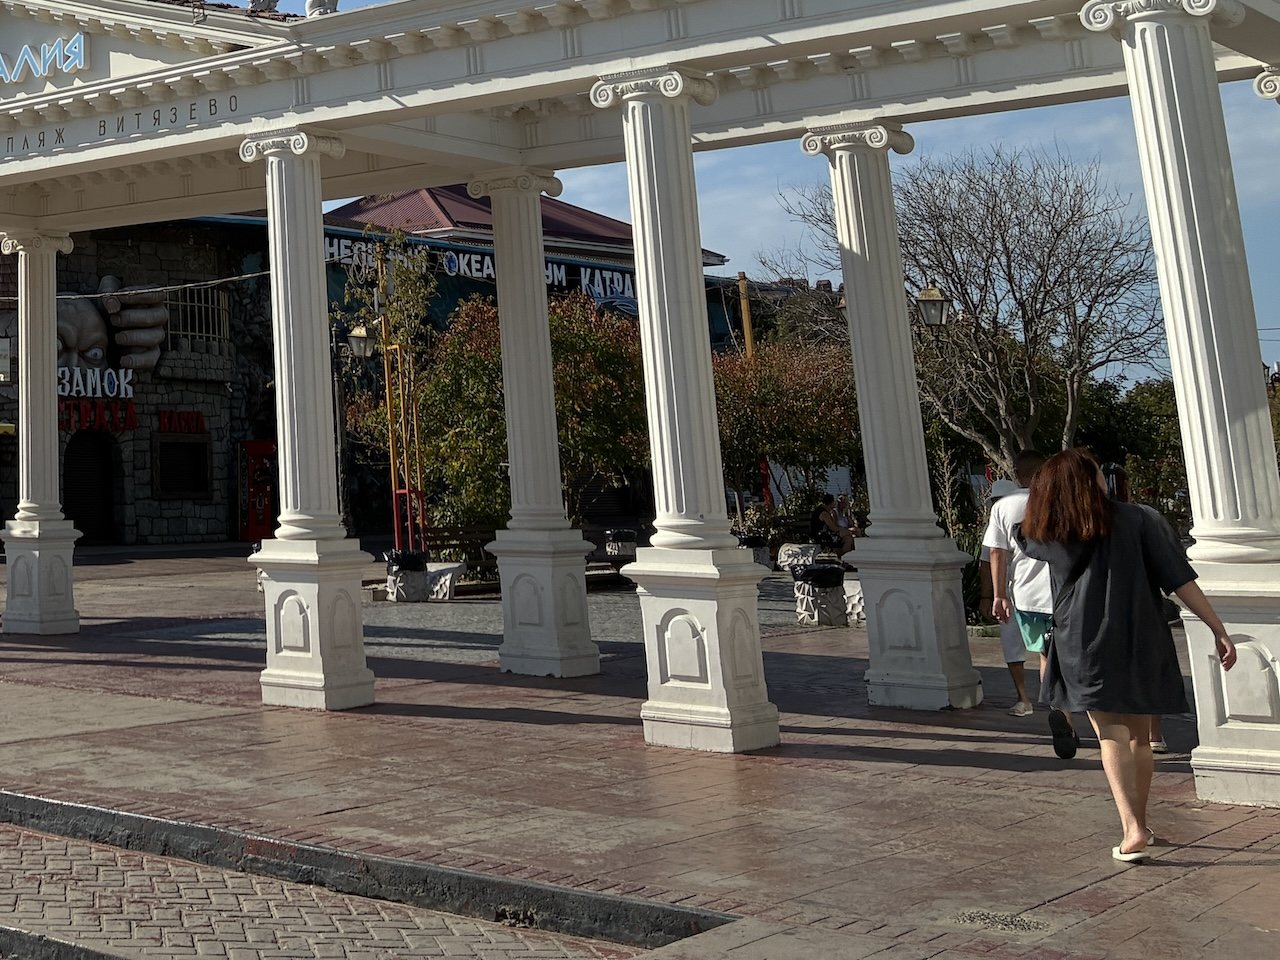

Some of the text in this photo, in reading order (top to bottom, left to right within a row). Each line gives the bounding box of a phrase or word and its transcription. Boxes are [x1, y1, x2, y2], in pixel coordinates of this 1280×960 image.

[6, 127, 65, 153] ПЛЯЖ
[98, 94, 238, 136] ВИТЯЗЕВО
[57, 366, 134, 399] ЗАМОК
